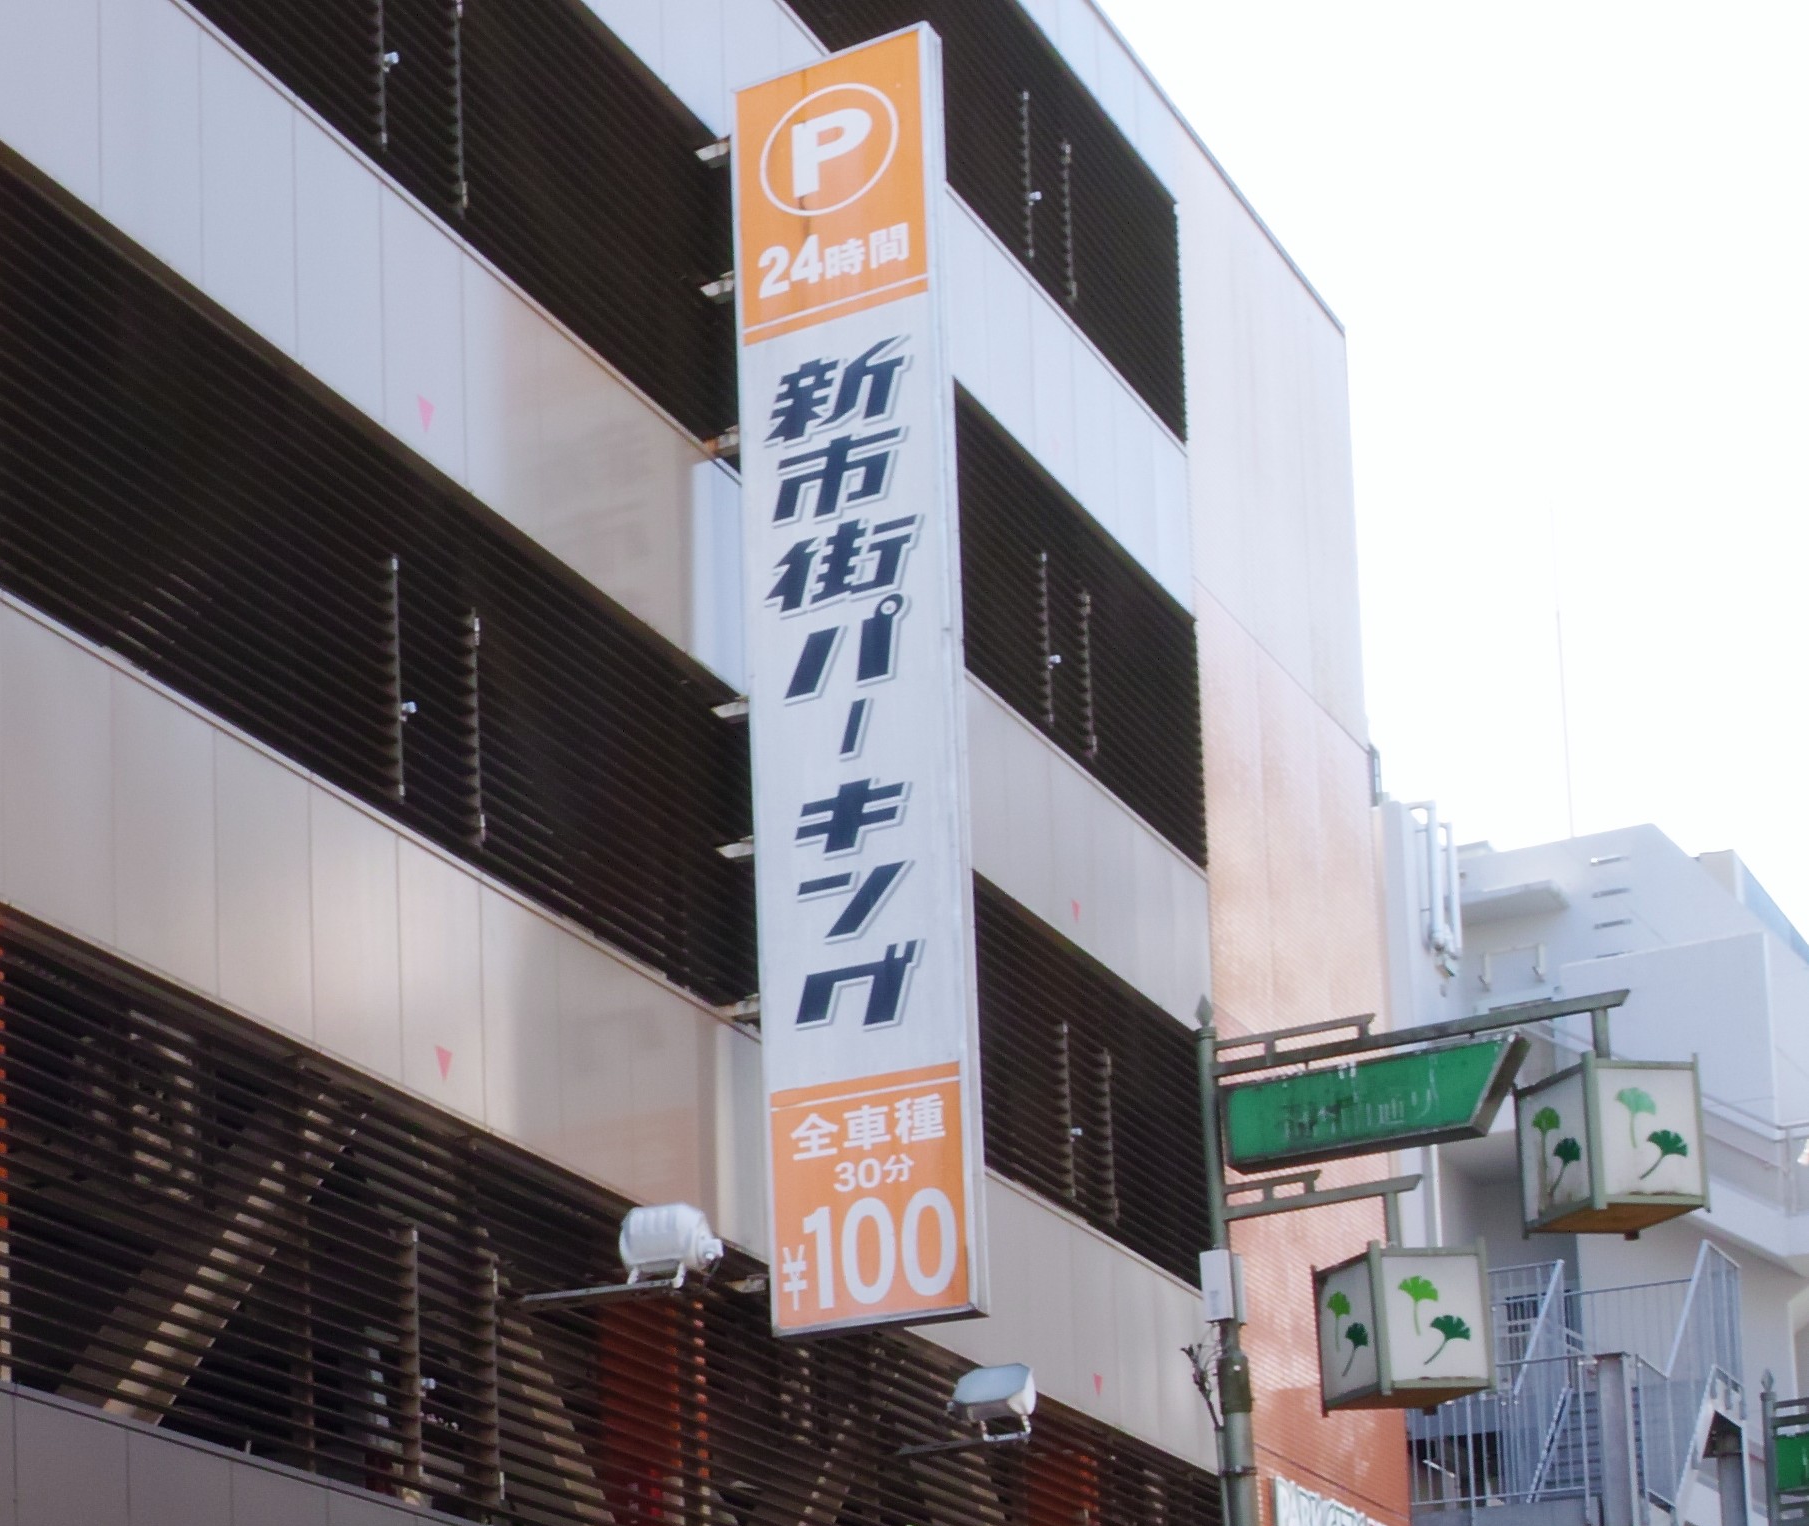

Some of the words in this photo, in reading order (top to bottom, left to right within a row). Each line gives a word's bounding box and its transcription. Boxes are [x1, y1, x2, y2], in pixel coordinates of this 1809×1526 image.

[792, 106, 872, 199] P
[758, 222, 910, 299] 24時間
[764, 335, 921, 1028] 新市街パーキング
[790, 1092, 946, 1162] 全車種
[832, 1153, 915, 1192] 30分
[782, 1188, 957, 1312] ¥100
